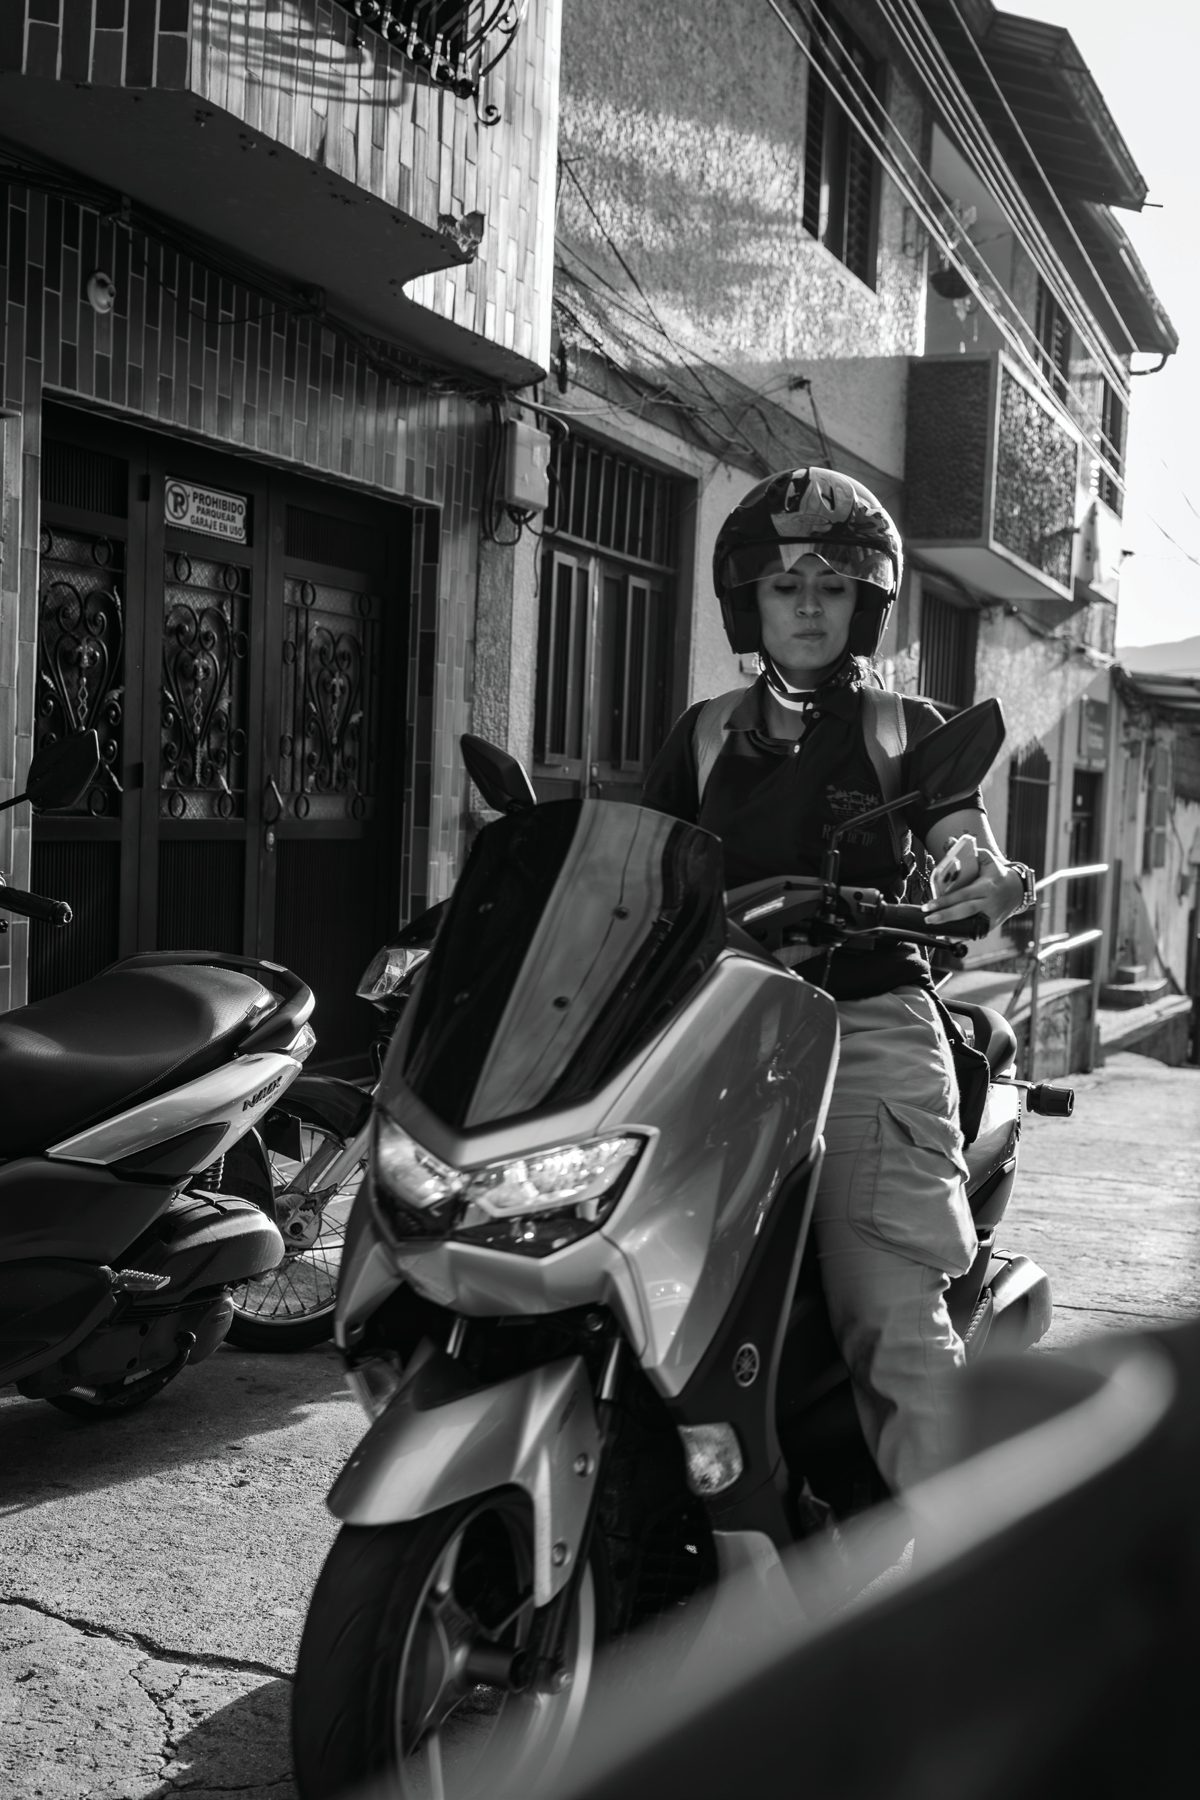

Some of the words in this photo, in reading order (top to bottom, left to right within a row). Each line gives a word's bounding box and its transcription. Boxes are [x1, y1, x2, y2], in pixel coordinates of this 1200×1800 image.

[192, 491, 244, 515] PROHIBIDO
[196, 505, 236, 523] PARQUEAR
[190, 515, 218, 531] GARAJE
[218, 521, 228, 533] EN
[229, 525, 243, 537] USO
[242, 1075, 283, 1112] NMAX
